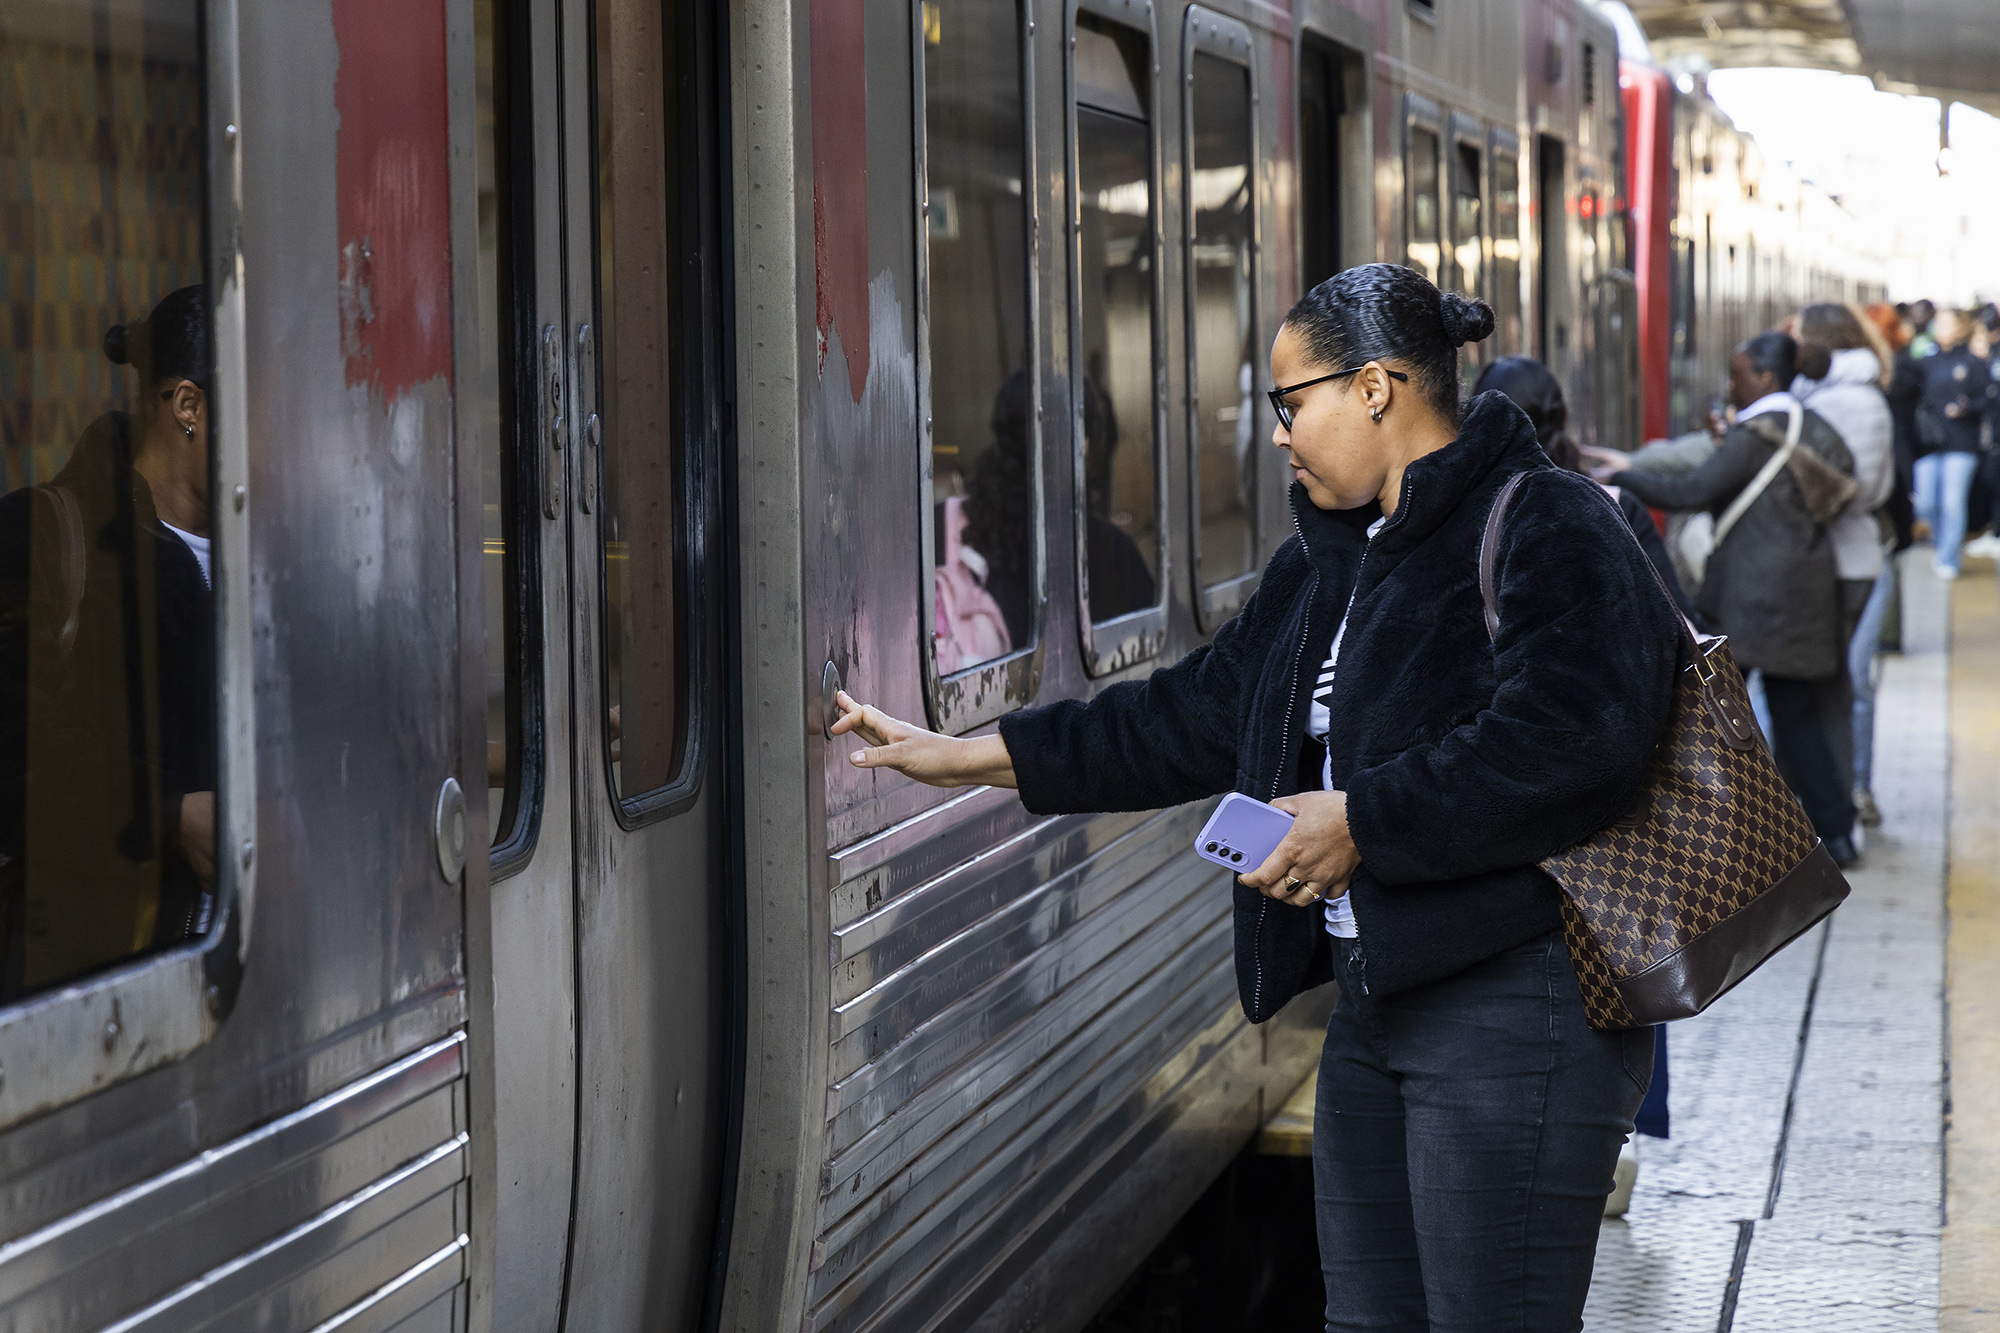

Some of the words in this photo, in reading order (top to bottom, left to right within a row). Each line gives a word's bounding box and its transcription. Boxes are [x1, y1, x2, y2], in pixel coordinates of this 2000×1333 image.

[1670, 759, 1685, 774] M
[1690, 740, 1706, 757] M
[1671, 740, 1687, 756] M
[1691, 721, 1708, 738] M
[1688, 760, 1705, 776] M
[1710, 742, 1724, 758] M
[1692, 704, 1708, 720] M
[1559, 856, 1577, 872] M
[1583, 844, 1600, 857] M
[1650, 802, 1663, 817] M
[1669, 788, 1685, 802] M
[1687, 778, 1704, 792] M
[1708, 760, 1723, 776] M
[1573, 895, 1590, 911] M
[1597, 880, 1614, 896] M
[1619, 865, 1636, 882] M
[1641, 852, 1658, 868] M
[1661, 840, 1678, 855] M
[1683, 826, 1699, 842] M
[1705, 812, 1721, 828] M
[1726, 799, 1739, 814] M
[1741, 788, 1752, 803] M
[1754, 777, 1764, 792] M
[1766, 767, 1777, 781] M
[1576, 876, 1594, 893] M
[1600, 862, 1617, 878] M
[1622, 848, 1639, 864] M
[1643, 835, 1659, 850] M
[1663, 823, 1680, 839] M
[1685, 808, 1702, 824] M
[1706, 795, 1722, 810] M
[1726, 782, 1740, 797] M
[1740, 770, 1752, 786] M
[1753, 760, 1764, 775] M
[1580, 858, 1598, 875] M
[1603, 843, 1620, 860] M
[1624, 830, 1641, 846] M
[1646, 819, 1661, 834] M
[1666, 805, 1683, 820] M
[1688, 791, 1704, 806] M
[1707, 779, 1723, 794] M
[1726, 764, 1740, 780] M
[1587, 918, 1604, 934] M
[1612, 902, 1628, 920] M
[1635, 887, 1652, 904] M
[1658, 874, 1674, 890] M
[1678, 861, 1695, 877] M
[1699, 848, 1715, 865] M
[1720, 835, 1735, 851] M
[1739, 822, 1752, 838] M
[1754, 811, 1765, 827] M
[1766, 801, 1776, 816] M
[1778, 791, 1788, 805] M
[1592, 899, 1608, 916] M
[1615, 884, 1632, 900] M
[1638, 870, 1655, 886] M
[1660, 857, 1676, 872] M
[1679, 845, 1696, 860] M
[1701, 831, 1717, 847] M
[1723, 817, 1738, 833] M
[1740, 805, 1752, 820] M
[1754, 794, 1765, 810] M
[1765, 784, 1776, 799] M
[1600, 941, 1617, 957] M
[1625, 926, 1642, 944] M
[1650, 911, 1667, 928] M
[1673, 896, 1689, 913] M
[1694, 884, 1709, 900] M
[1714, 871, 1729, 888] M
[1734, 859, 1748, 875] M
[1751, 847, 1763, 863] M
[1766, 836, 1778, 851] M
[1778, 824, 1788, 840] M
[1790, 815, 1800, 829] M
[1606, 922, 1622, 939] M
[1631, 906, 1648, 924] M
[1654, 892, 1671, 909] M
[1676, 879, 1692, 895] M
[1696, 866, 1712, 882] M
[1717, 853, 1732, 869] M
[1737, 841, 1750, 857] M
[1752, 829, 1764, 845] M
[1766, 818, 1777, 833] M
[1778, 808, 1789, 823] M
[1614, 963, 1630, 978] M
[1638, 950, 1655, 967] M
[1664, 934, 1680, 952] M
[1687, 921, 1701, 937] M
[1706, 908, 1720, 925] M
[1726, 896, 1740, 912] M
[1746, 884, 1757, 900] M
[1762, 872, 1773, 888] M
[1777, 860, 1787, 876] M
[1789, 849, 1800, 864] M
[1619, 945, 1636, 962] M
[1645, 930, 1661, 948] M
[1669, 915, 1685, 932] M
[1690, 902, 1704, 919] M
[1710, 890, 1724, 906] M
[1730, 877, 1744, 894] M
[1749, 865, 1761, 881] M
[1764, 854, 1776, 870] M
[1778, 842, 1788, 858] M
[1790, 832, 1801, 847] M
[1583, 961, 1594, 974] M
[1591, 986, 1603, 997] M
[1598, 975, 1610, 987] M
[1600, 1009, 1613, 1020] M
